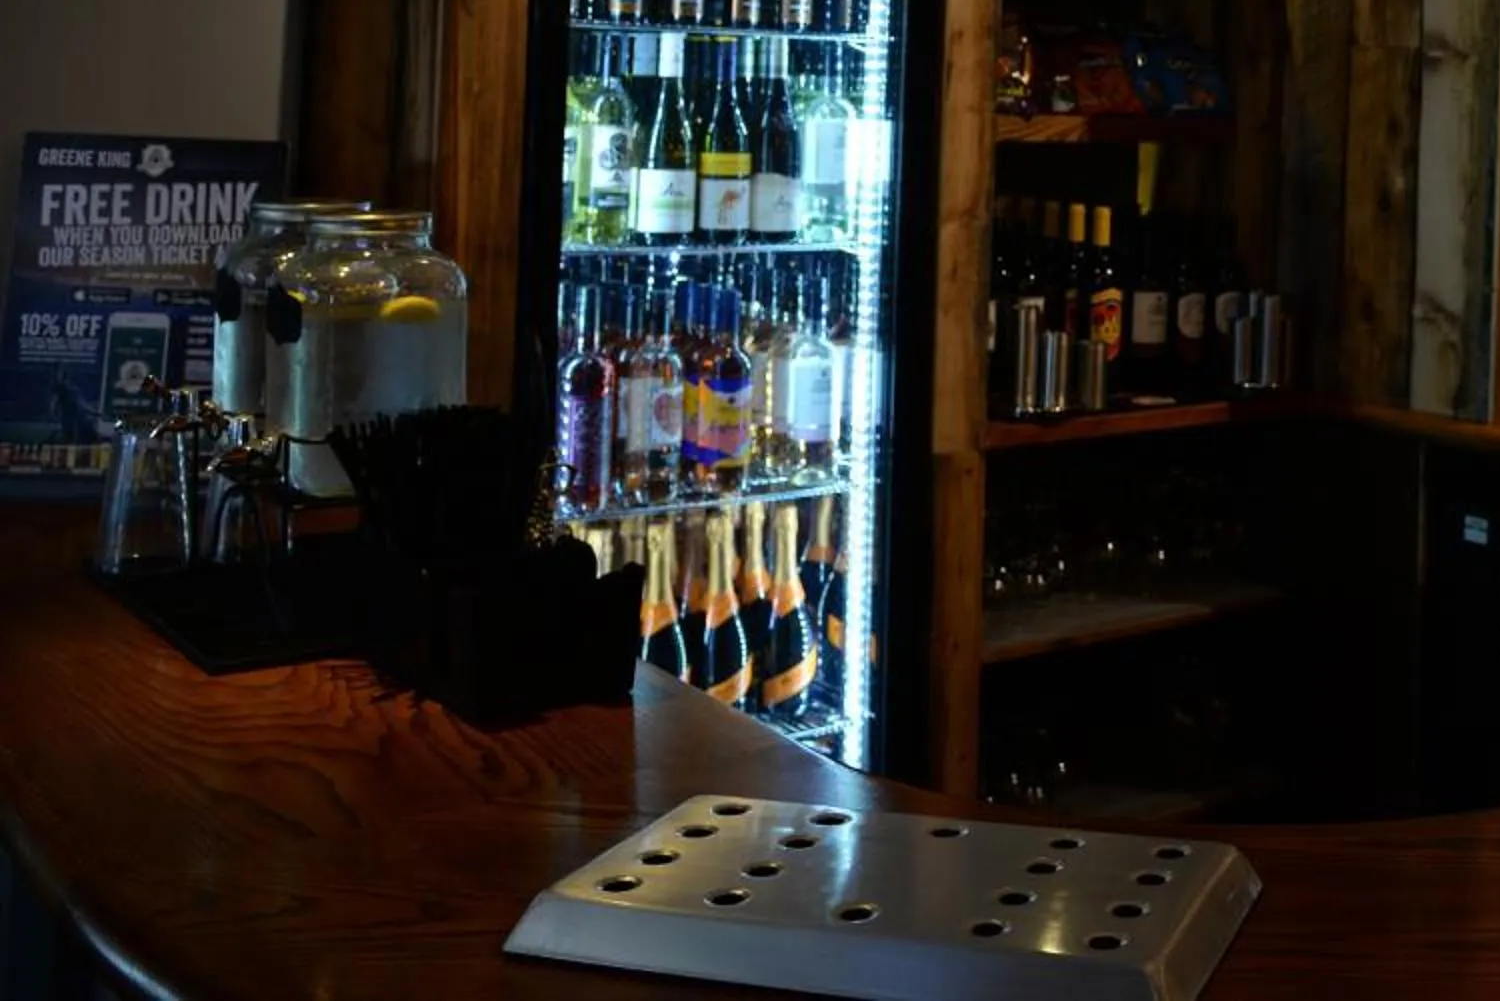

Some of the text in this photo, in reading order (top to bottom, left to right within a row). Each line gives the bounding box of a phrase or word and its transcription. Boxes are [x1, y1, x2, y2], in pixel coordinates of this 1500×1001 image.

[39, 147, 131, 169] GREENE KING
[41, 182, 259, 227] FREE DRINK
[53, 224, 244, 246] WHEN YOU DOWNLOAD
[38, 246, 74, 267] OUR
[79, 246, 145, 266] SEASON
[152, 244, 209, 265] TICKET
[20, 313, 103, 336] 10% OFF
